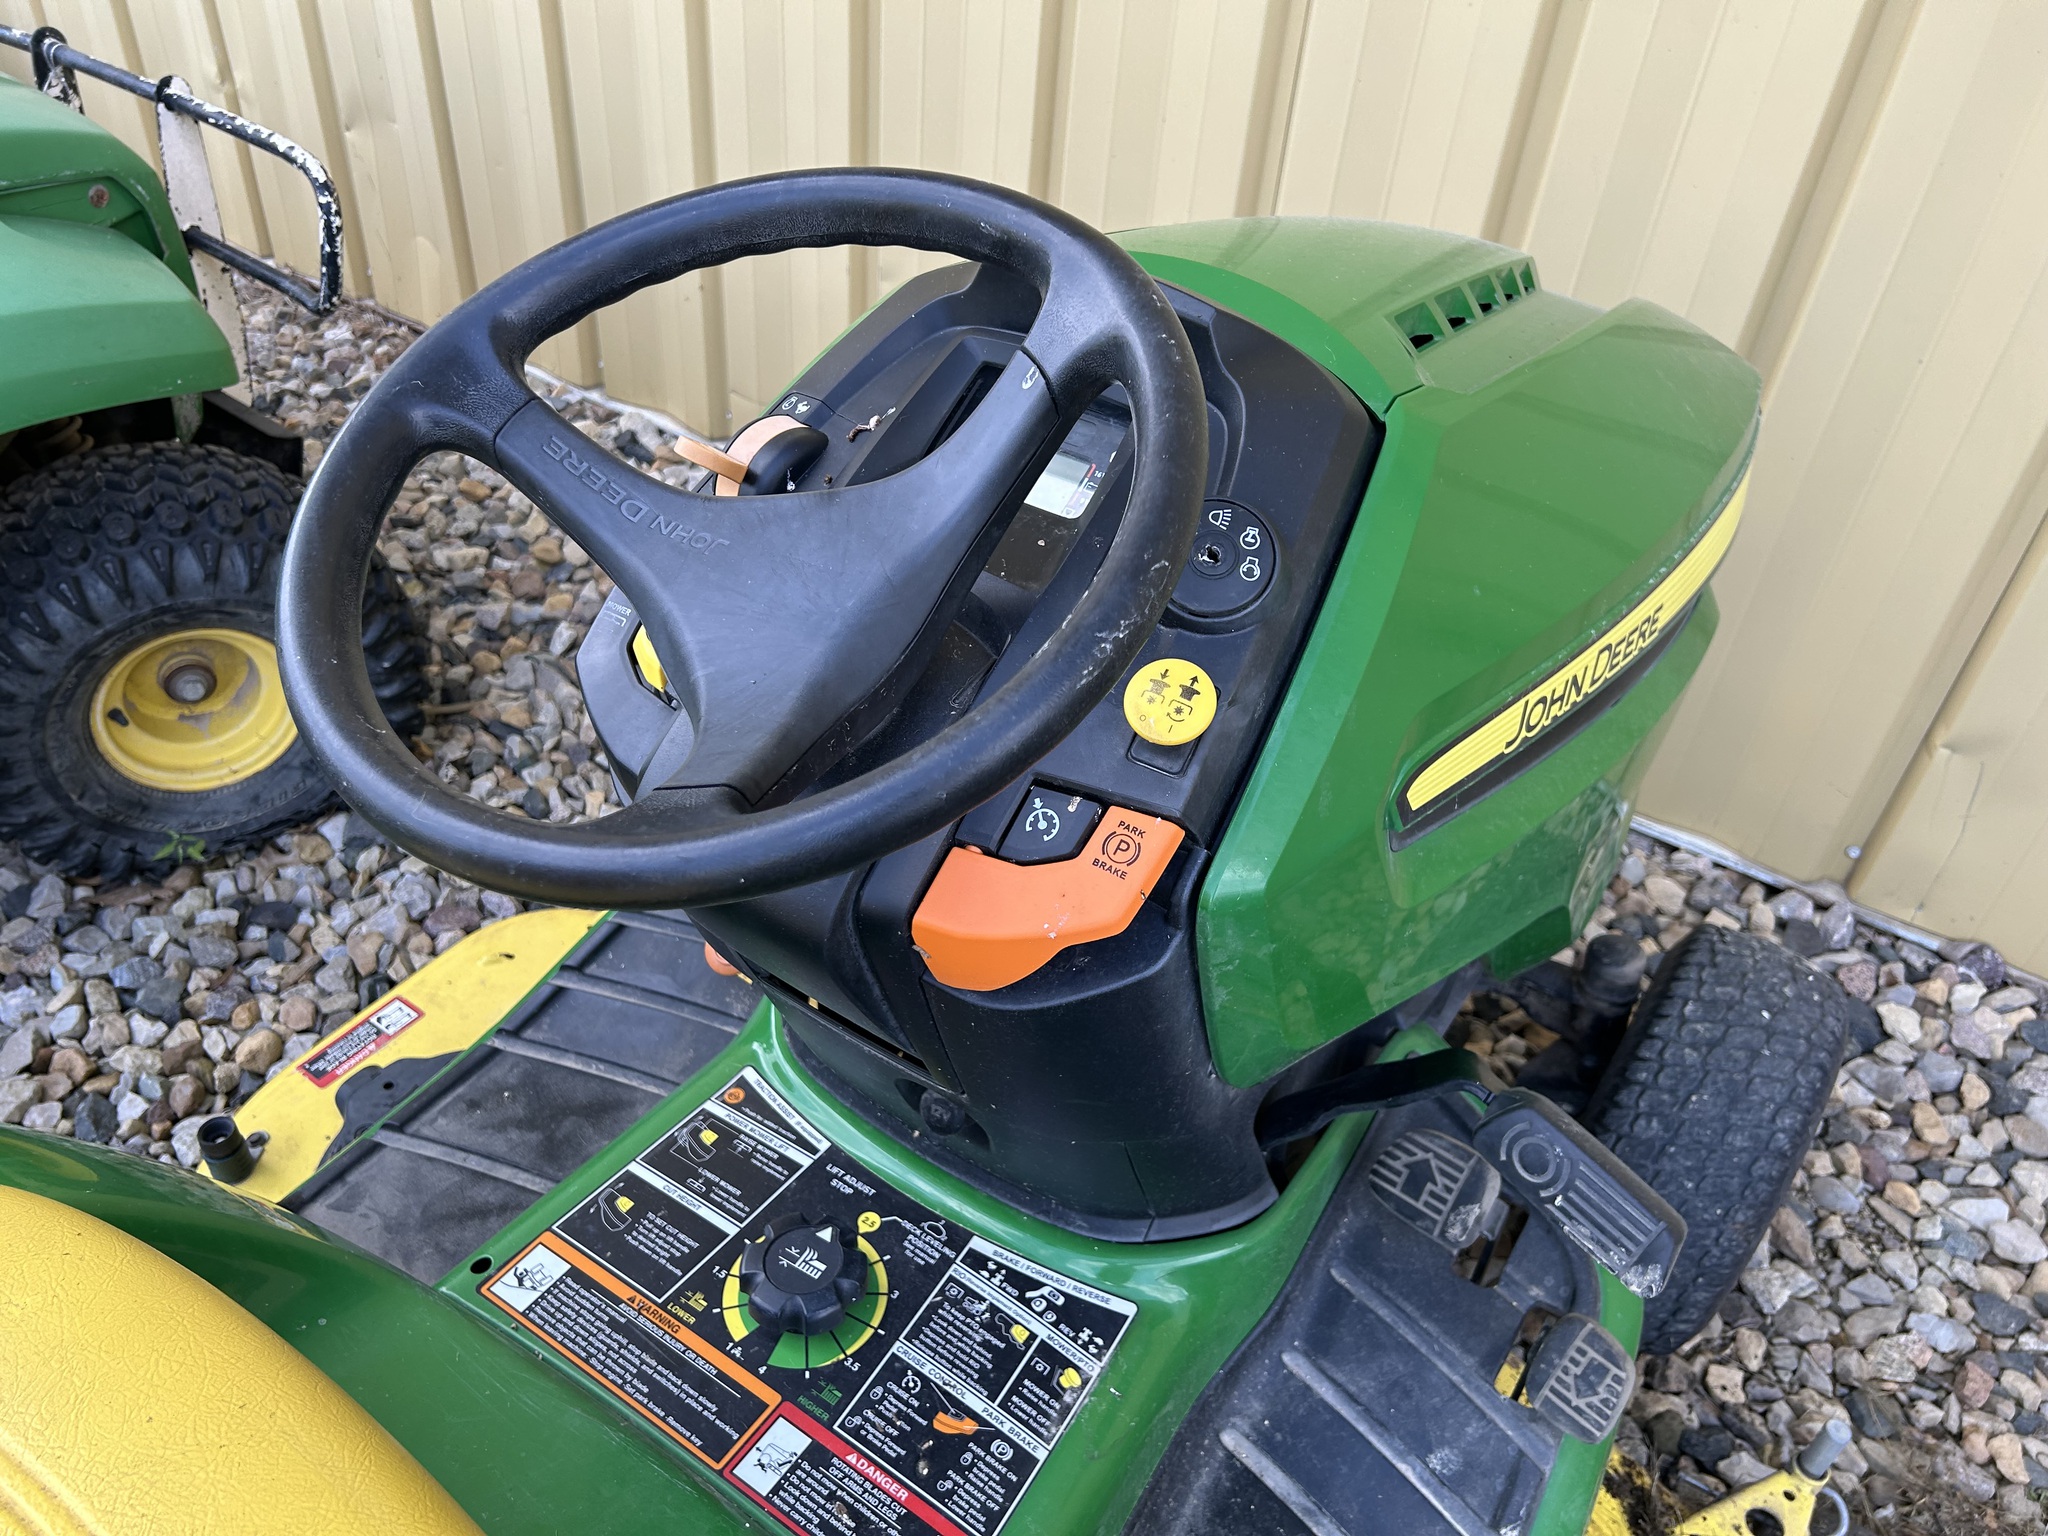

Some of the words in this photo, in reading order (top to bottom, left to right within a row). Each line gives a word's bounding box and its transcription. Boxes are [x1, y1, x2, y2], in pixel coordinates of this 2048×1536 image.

[542, 435, 650, 523] DEERE
[650, 514, 730, 555] JOHN
[607, 600, 633, 617] MOWER
[1504, 664, 1589, 751] JOHN
[1587, 603, 1664, 690] DEERE
[1117, 820, 1146, 839] PARK
[1092, 857, 1128, 880] BRAKE
[723, 1113, 750, 1130] POWER
[747, 1127, 775, 1144] MOWER
[773, 1141, 790, 1152] LIFT
[824, 1163, 845, 1177] LIFT
[842, 1173, 876, 1195] ADJUST
[828, 1178, 854, 1195] STOP
[661, 1184, 677, 1196] CUT
[674, 1192, 702, 1211] HEIGHT
[859, 1215, 878, 1228] 2.5
[906, 1234, 941, 1258] POSITION
[709, 1264, 729, 1278] 1.5
[991, 1249, 1022, 1266] BRAKE
[1024, 1264, 1068, 1286] FORWARD
[1071, 1284, 1112, 1305] REVERSE
[889, 1289, 900, 1299] 3
[1000, 1282, 1020, 1297] FWD
[634, 1299, 682, 1333] WARNING
[665, 1301, 697, 1325] LOWER
[618, 1302, 638, 1317] AVOID
[636, 1315, 665, 1336] SERIOUS
[662, 1333, 686, 1352] INJURY
[684, 1349, 697, 1360] OR
[694, 1356, 718, 1375] DEATH
[723, 1341, 734, 1350] 1
[1058, 1323, 1076, 1338] REV
[841, 1356, 862, 1372] 3.5
[1045, 1333, 1096, 1371] MOWER/PTO
[756, 1363, 769, 1375] 4
[895, 1345, 927, 1369] CRUISE
[926, 1367, 968, 1399] CONTROL
[796, 1394, 831, 1422] HIGHER
[885, 1381, 909, 1400] CRUISE
[907, 1396, 920, 1407] ON
[1022, 1378, 1049, 1401] MOWER
[1048, 1397, 1061, 1410] ON
[862, 1408, 886, 1428] CRUISE
[884, 1424, 899, 1438] OFF
[1010, 1394, 1038, 1417] MOWER
[1036, 1413, 1051, 1427] OFF
[981, 1406, 1006, 1428] PARK
[1006, 1426, 1040, 1453] BRAKE
[967, 1441, 985, 1457] PARK
[984, 1454, 1007, 1474] BRAKE
[1006, 1470, 1018, 1482] ON
[788, 1474, 801, 1485] Do
[798, 1481, 812, 1494] not
[809, 1491, 826, 1505] mow
[794, 1469, 806, 1479] are
[804, 1475, 829, 1495] around
[827, 1466, 844, 1480] OFF
[841, 1476, 864, 1495] ARMS
[861, 1491, 879, 1507] AND
[876, 1502, 898, 1521] LEGS
[830, 1456, 865, 1484] ROTATING
[862, 1480, 892, 1505] BLADES
[890, 1500, 907, 1516] CUT
[855, 1457, 910, 1501] DANGER
[946, 1469, 964, 1485] PARK
[963, 1482, 988, 1503] BRAKE
[986, 1499, 999, 1512] OFF
[771, 1495, 791, 1513] Never
[788, 1510, 806, 1526] carry
[777, 1489, 796, 1505] while
[793, 1501, 820, 1525] backing
[783, 1481, 801, 1497] Look
[798, 1493, 818, 1510] down
[816, 1506, 831, 1520] and
[828, 1516, 852, 1536] behind
[800, 1461, 811, 1471] Do
[809, 1468, 822, 1480] not
[820, 1477, 837, 1491] mow
[836, 1487, 855, 1504] when
[853, 1500, 880, 1523] children
[878, 1520, 887, 1529] or
